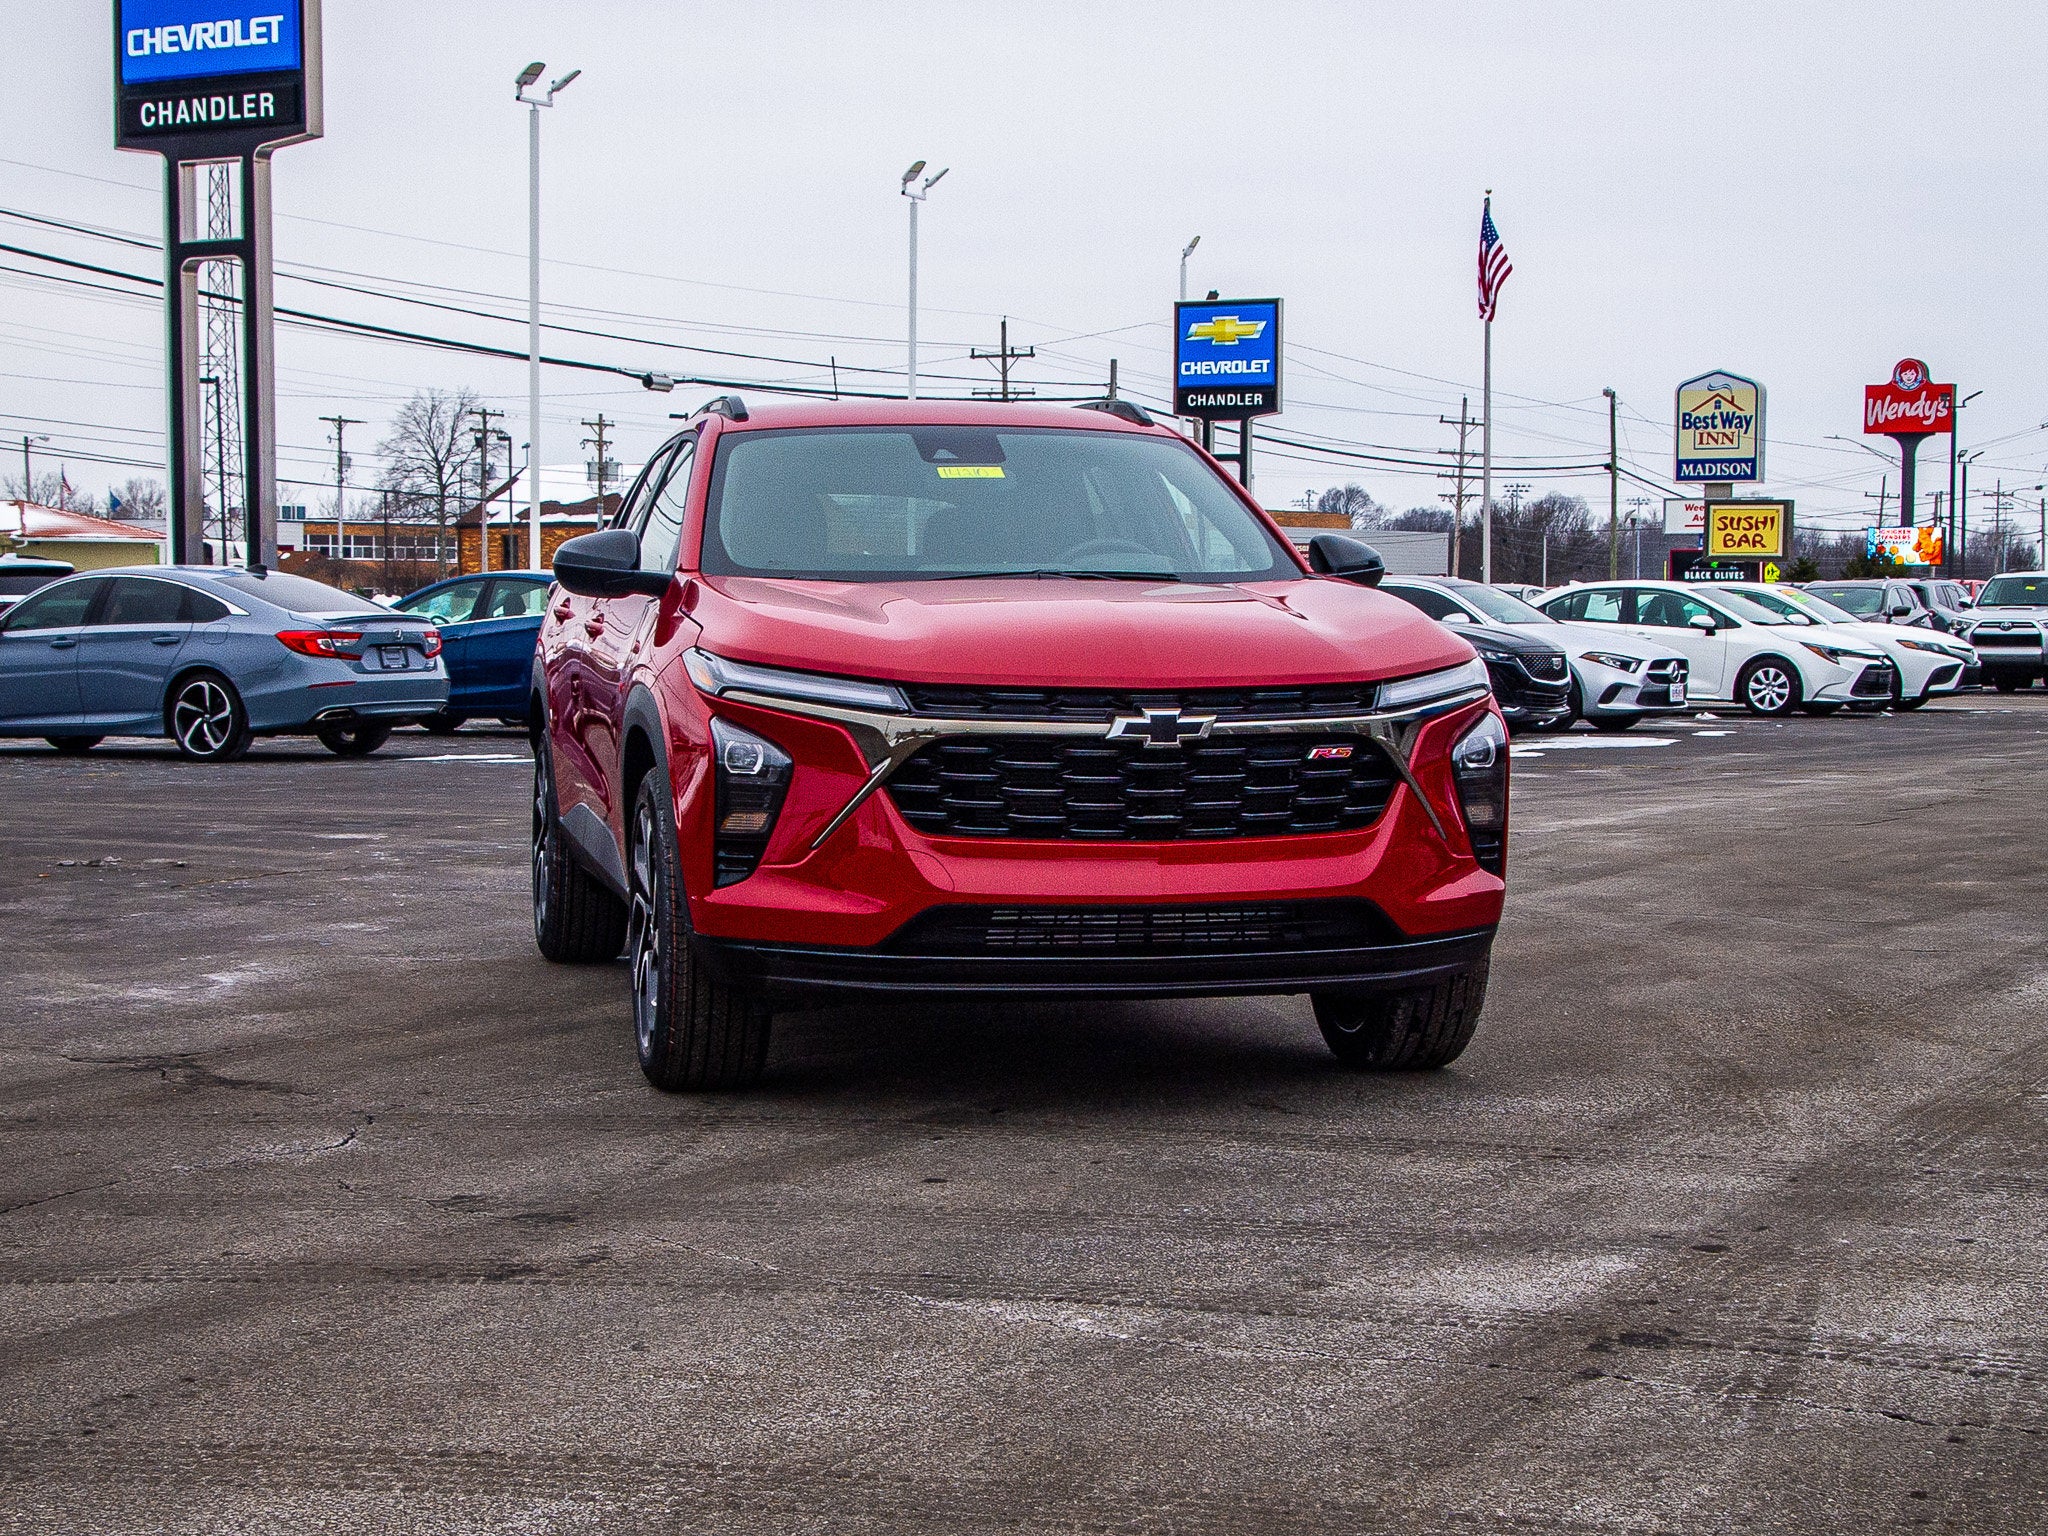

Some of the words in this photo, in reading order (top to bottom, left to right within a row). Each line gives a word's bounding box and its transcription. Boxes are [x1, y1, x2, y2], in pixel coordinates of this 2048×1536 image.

[127, 15, 284, 57] CHEVROLET
[140, 92, 275, 127] CHANDLER
[1181, 359, 1271, 376] CHEVROLET
[1187, 393, 1263, 406] CHANDLER
[1681, 411, 1718, 431] Best
[1720, 411, 1754, 435] Way
[1697, 431, 1736, 446] INN
[1680, 462, 1753, 477] MADISON
[1717, 515, 1775, 531] SUSHI
[1722, 533, 1767, 549] BAR
[1684, 571, 1712, 580] BLACK
[1714, 571, 1745, 580] OLIVES
[1307, 747, 1354, 759] RS
